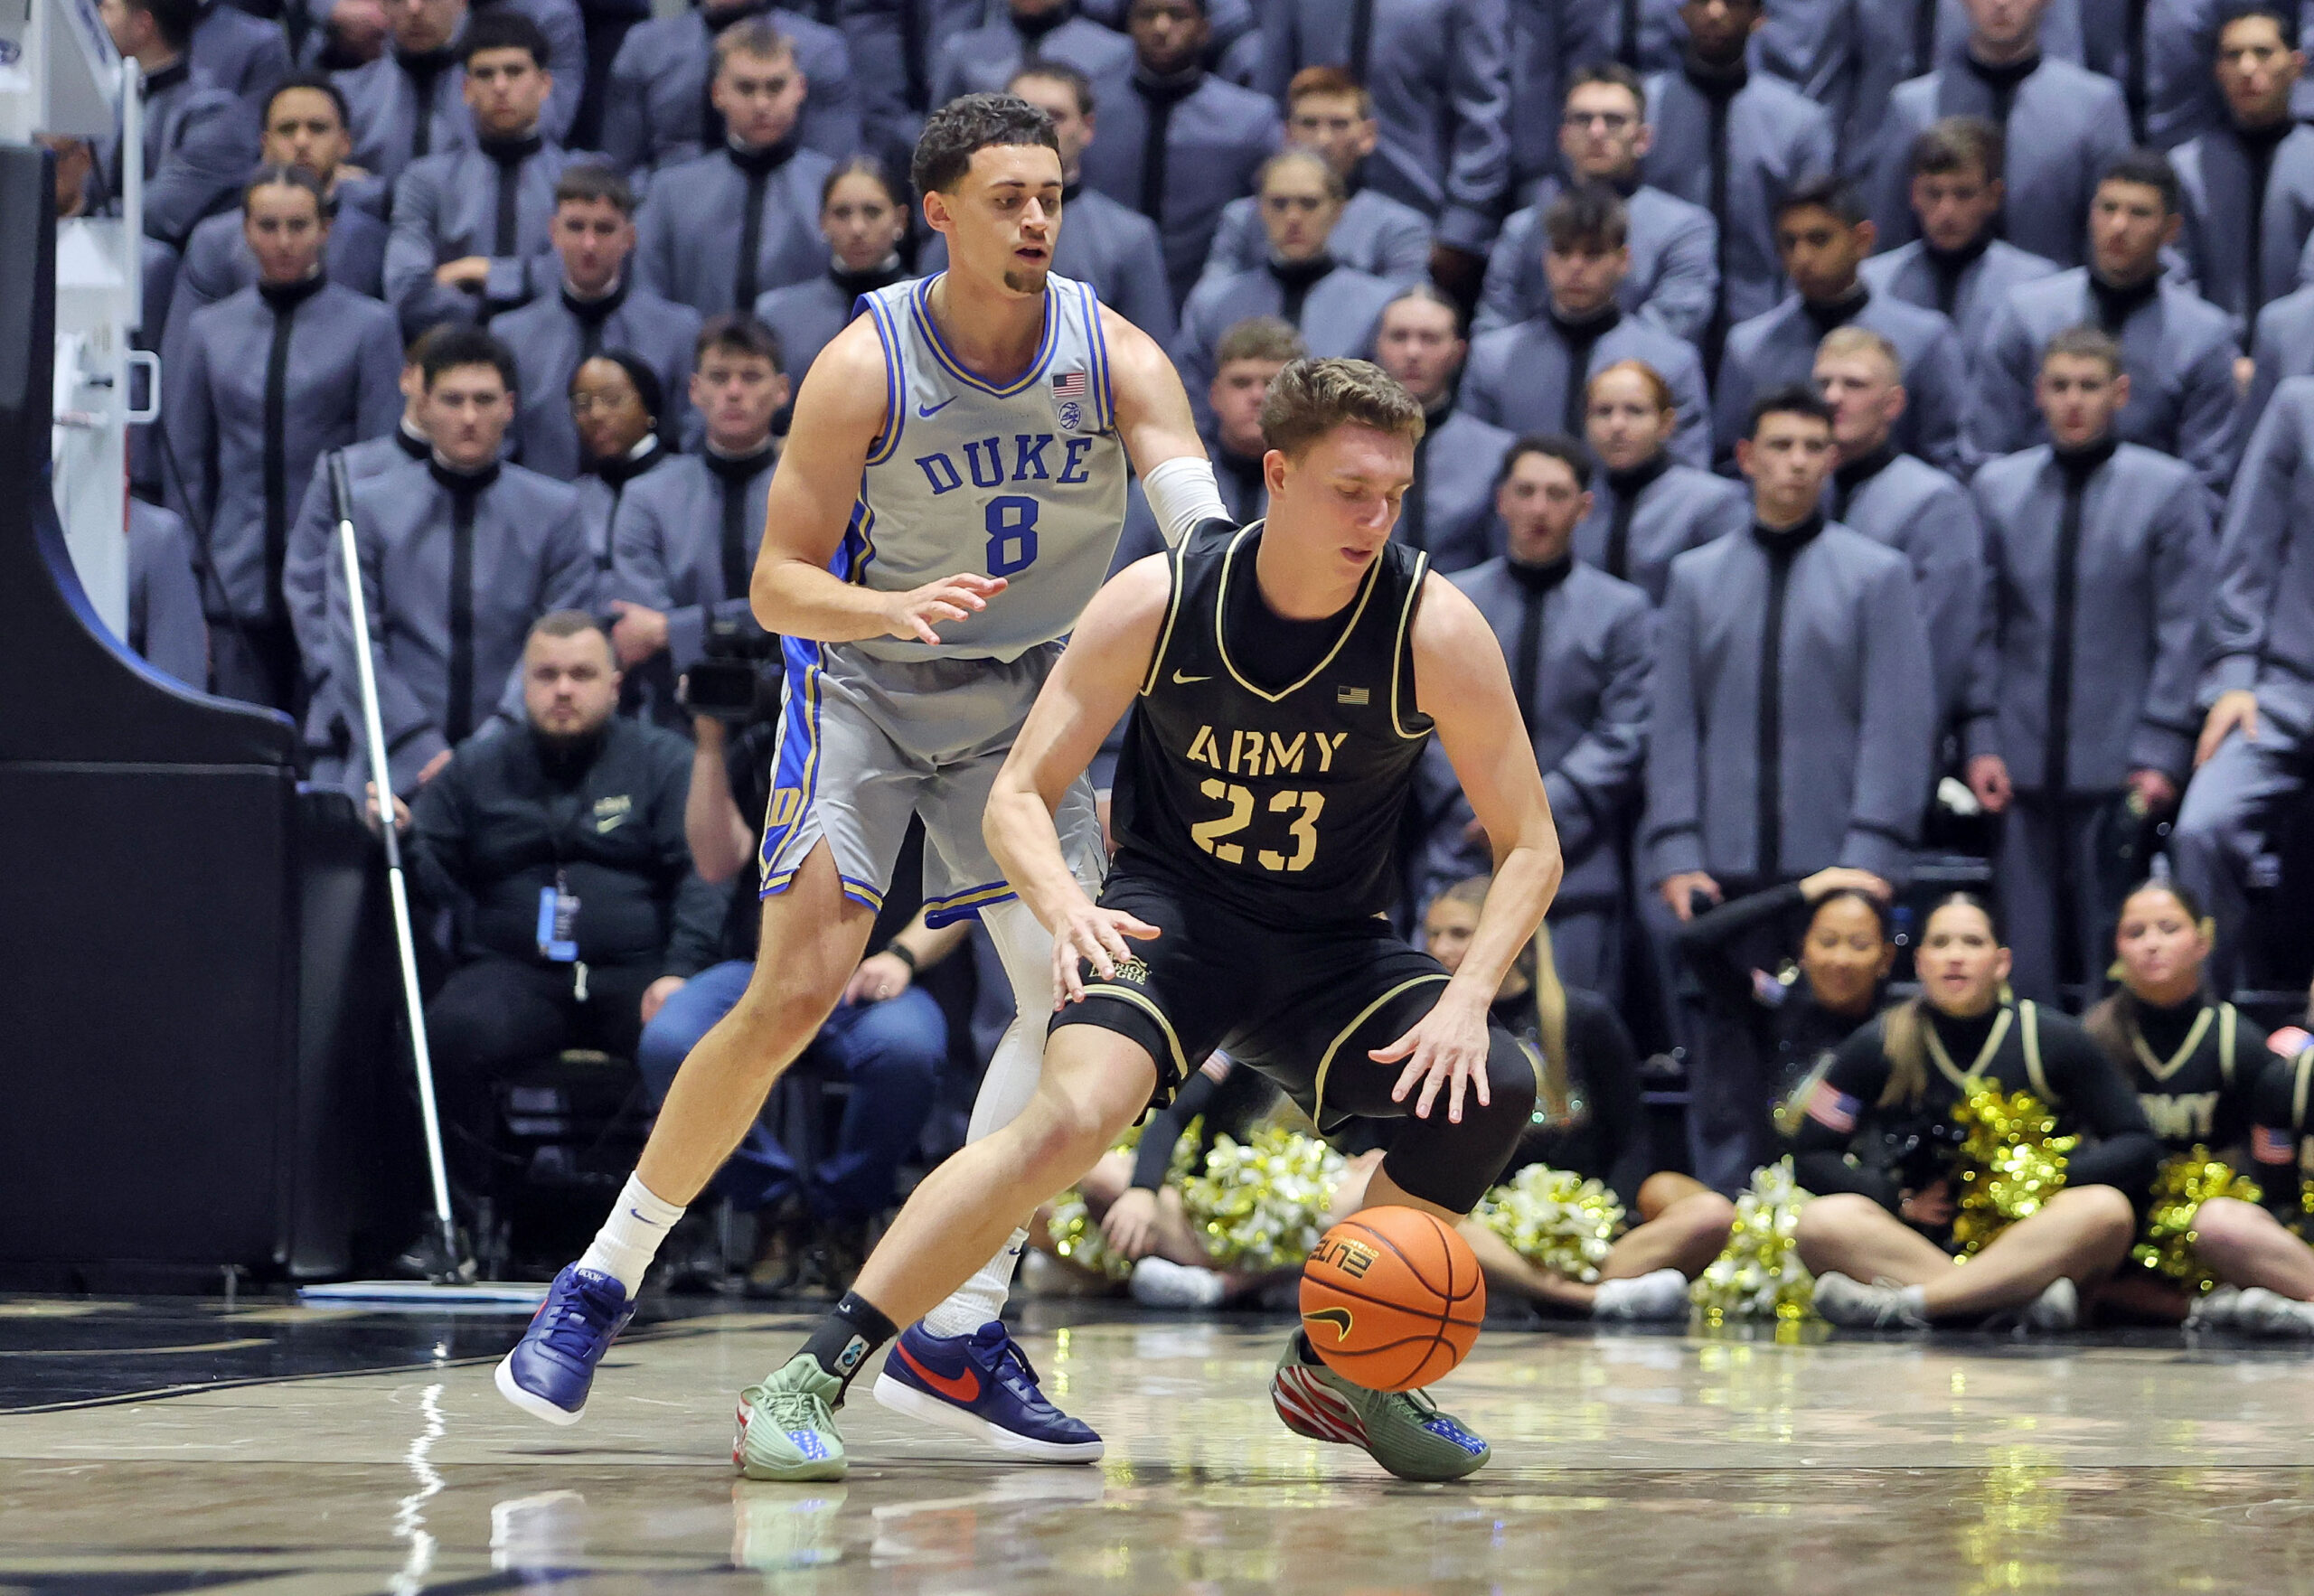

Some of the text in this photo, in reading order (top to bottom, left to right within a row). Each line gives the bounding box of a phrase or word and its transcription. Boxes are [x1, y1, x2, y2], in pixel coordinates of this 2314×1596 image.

[915, 435, 1093, 495] DUKE
[985, 495, 1039, 578] 8
[1186, 725, 1349, 776] ARMY
[1191, 777, 1326, 871] 23
[1088, 969, 1146, 985] LGUE
[1308, 1238, 1374, 1281] ELITE
